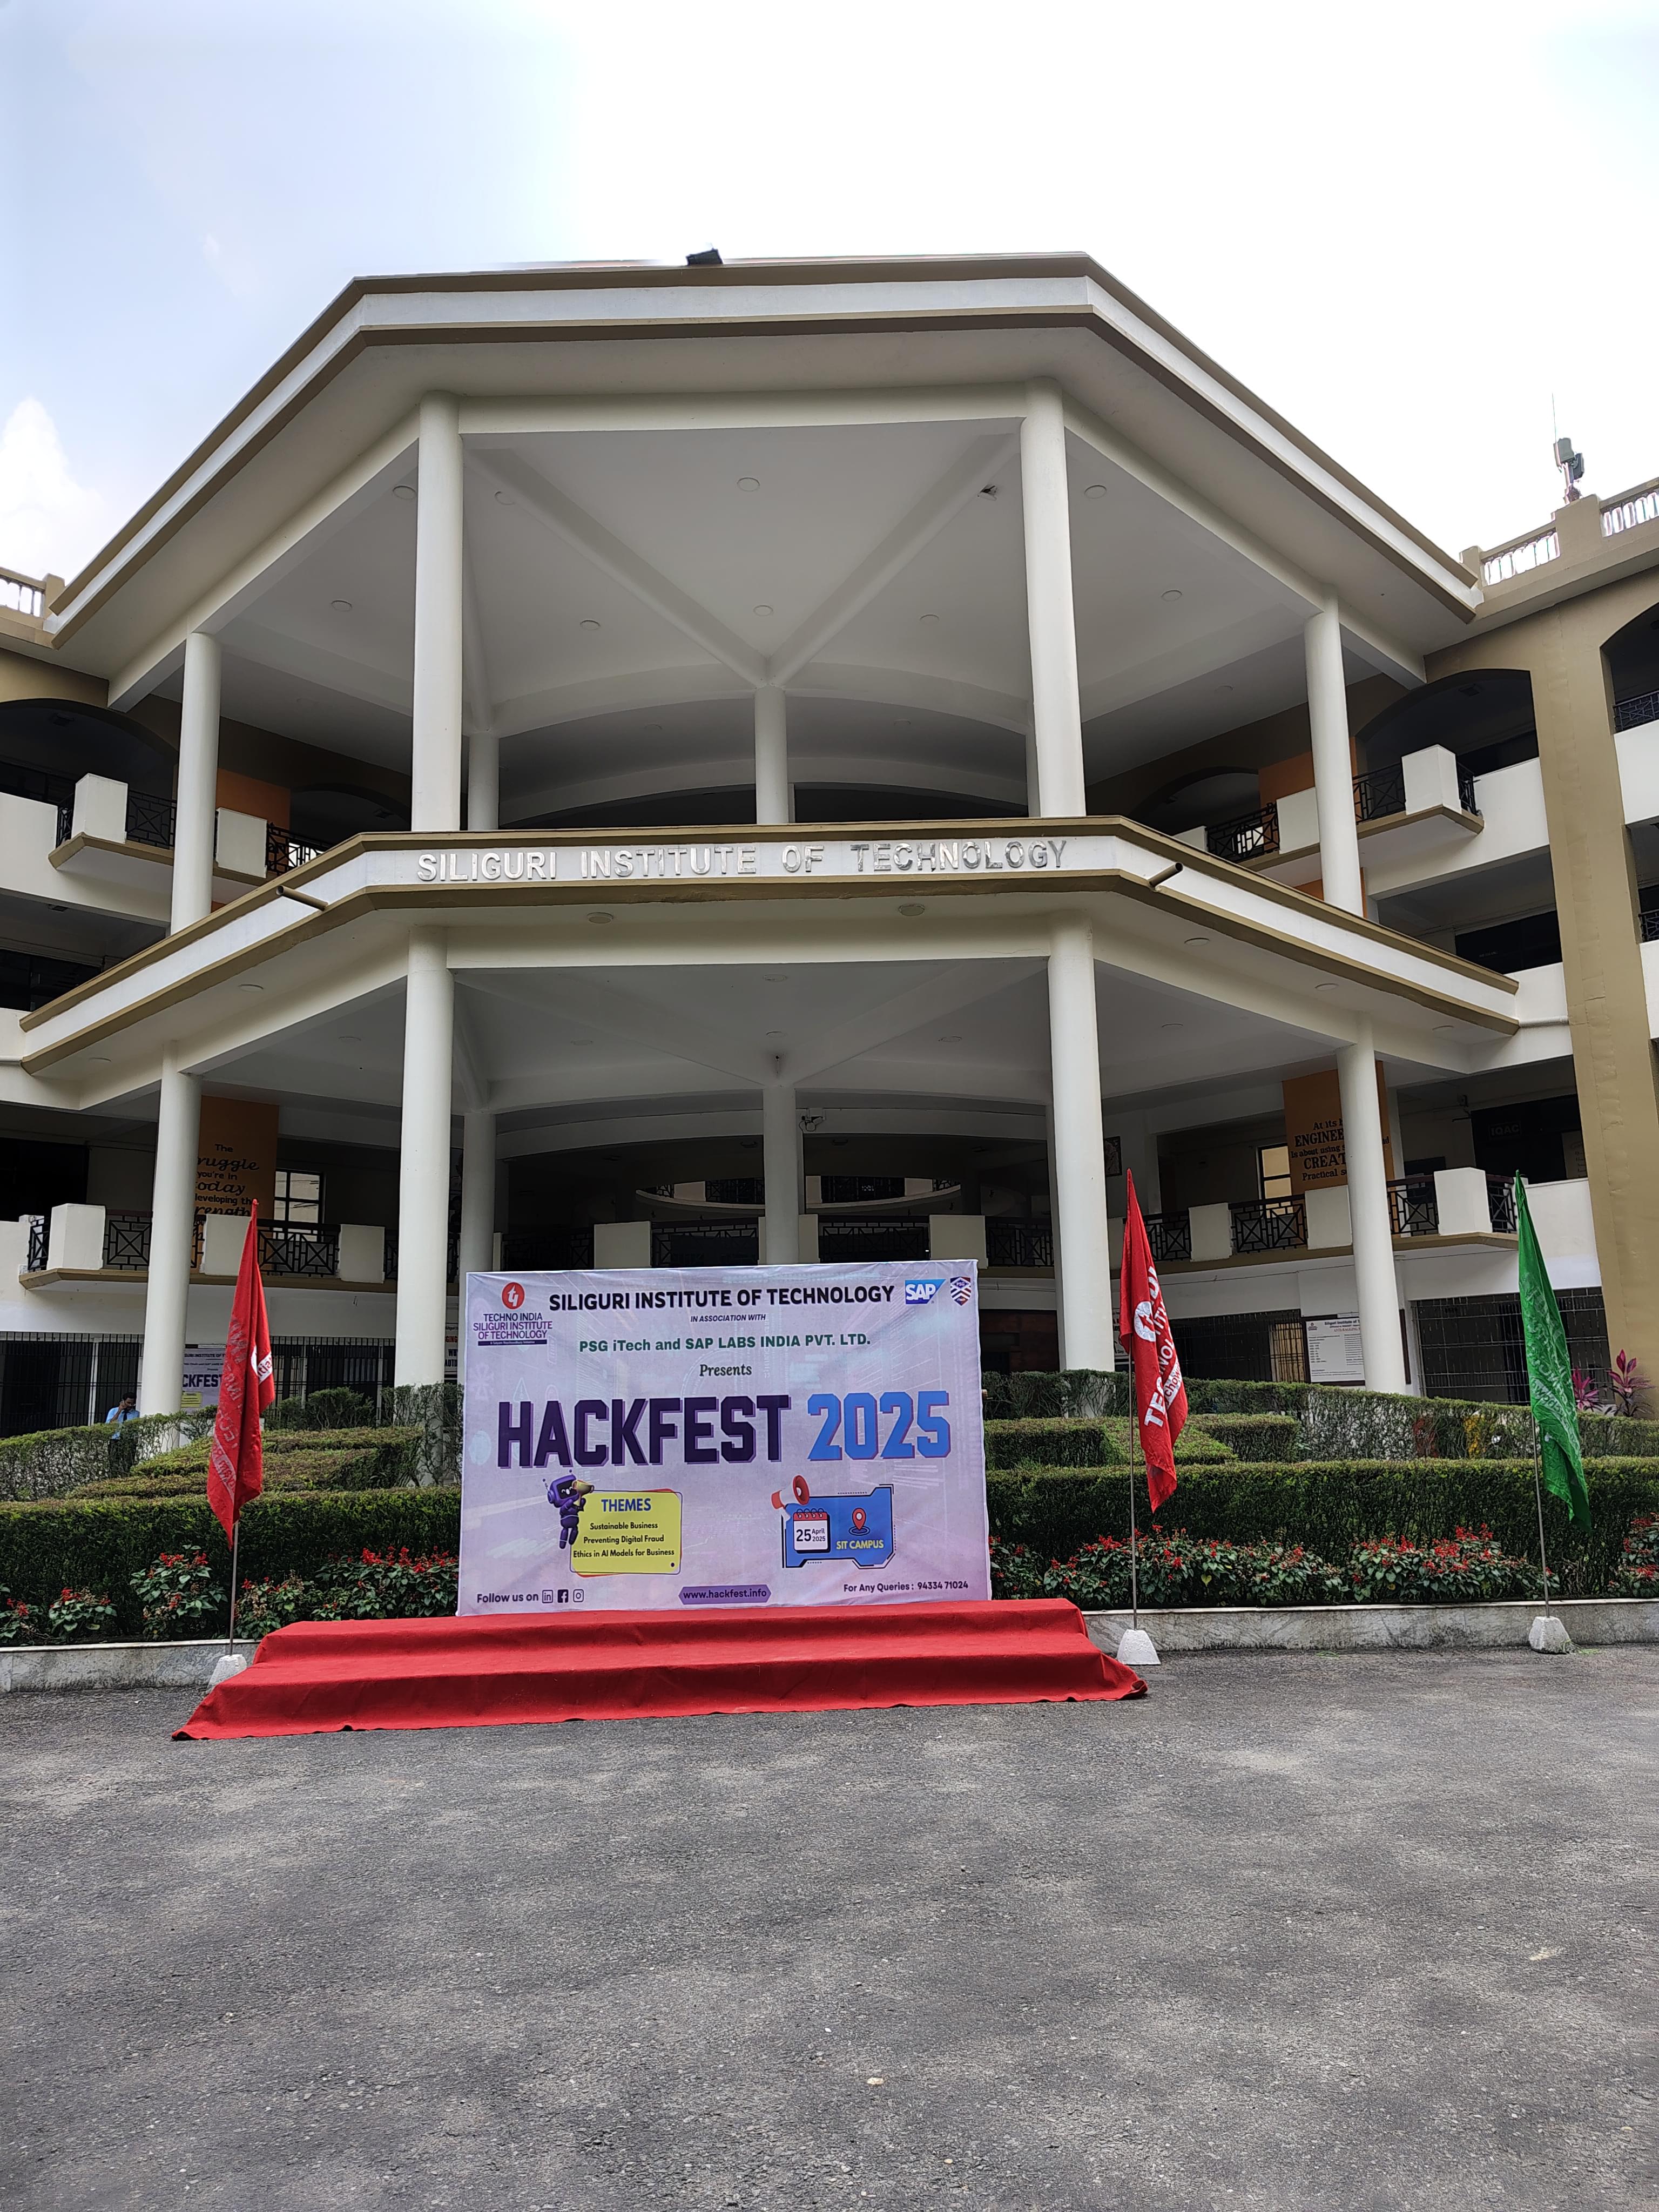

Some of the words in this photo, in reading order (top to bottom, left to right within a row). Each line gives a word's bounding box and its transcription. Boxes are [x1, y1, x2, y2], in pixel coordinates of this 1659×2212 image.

[417, 851, 556, 881] SILIGURI
[582, 846, 757, 878] INSTITUTE
[781, 844, 823, 873] OF
[850, 840, 1065, 873] TECHNOLOGY
[1326, 1120, 1337, 1128] its
[1294, 1128, 1345, 1147] ENGINEE
[215, 1143, 233, 1152] The
[1299, 1148, 1318, 1157] about
[1320, 1145, 1341, 1155] using
[198, 1157, 260, 1172] ruggle
[1304, 1152, 1346, 1170] CREAT
[1302, 1169, 1338, 1181] Practical
[195, 1181, 246, 1196] oday
[241, 1197, 252, 1205] th
[194, 1206, 251, 1216] rength
[549, 1293, 629, 1311] SILIGURI
[636, 1290, 732, 1308] INSTITUTE
[737, 1289, 761, 1306] OF
[767, 1285, 894, 1305] TECHNOLOGY
[906, 1284, 936, 1300] SAP
[483, 1313, 518, 1321] TECHNO
[520, 1312, 543, 1321] INDIA
[473, 1323, 508, 1331] SILIGURI
[510, 1321, 552, 1330] INSTITUTE
[491, 1330, 547, 1339] TECHNOLOGY
[579, 1340, 608, 1352] PSG
[613, 1339, 650, 1351] iTech
[655, 1338, 680, 1350] and
[685, 1338, 713, 1350] SAP
[718, 1336, 756, 1348] LABS
[760, 1336, 800, 1347] INDIA
[805, 1334, 835, 1346] PVT.
[840, 1333, 871, 1345] LTD.
[699, 1363, 752, 1377] Presents
[183, 1374, 222, 1387] CKFEST
[497, 1394, 791, 1469] HACKFEST
[807, 1390, 951, 1461] 2025
[601, 1498, 651, 1512] THEMES
[590, 1522, 629, 1530] Sustainable
[630, 1521, 658, 1529] Business
[584, 1536, 619, 1545] Preventing
[621, 1535, 643, 1544] Digital
[796, 1529, 811, 1542] 25
[836, 1541, 848, 1549] SIT
[849, 1540, 884, 1549] CAMPUS
[844, 1584, 857, 1592] For
[859, 1583, 875, 1593] Any
[918, 1581, 943, 1590] 94334
[945, 1581, 968, 1589] 71024
[477, 1593, 510, 1603] Follow
[512, 1594, 524, 1602] us
[526, 1593, 539, 1602] on
[683, 1588, 767, 1599] www.hackfest.info
